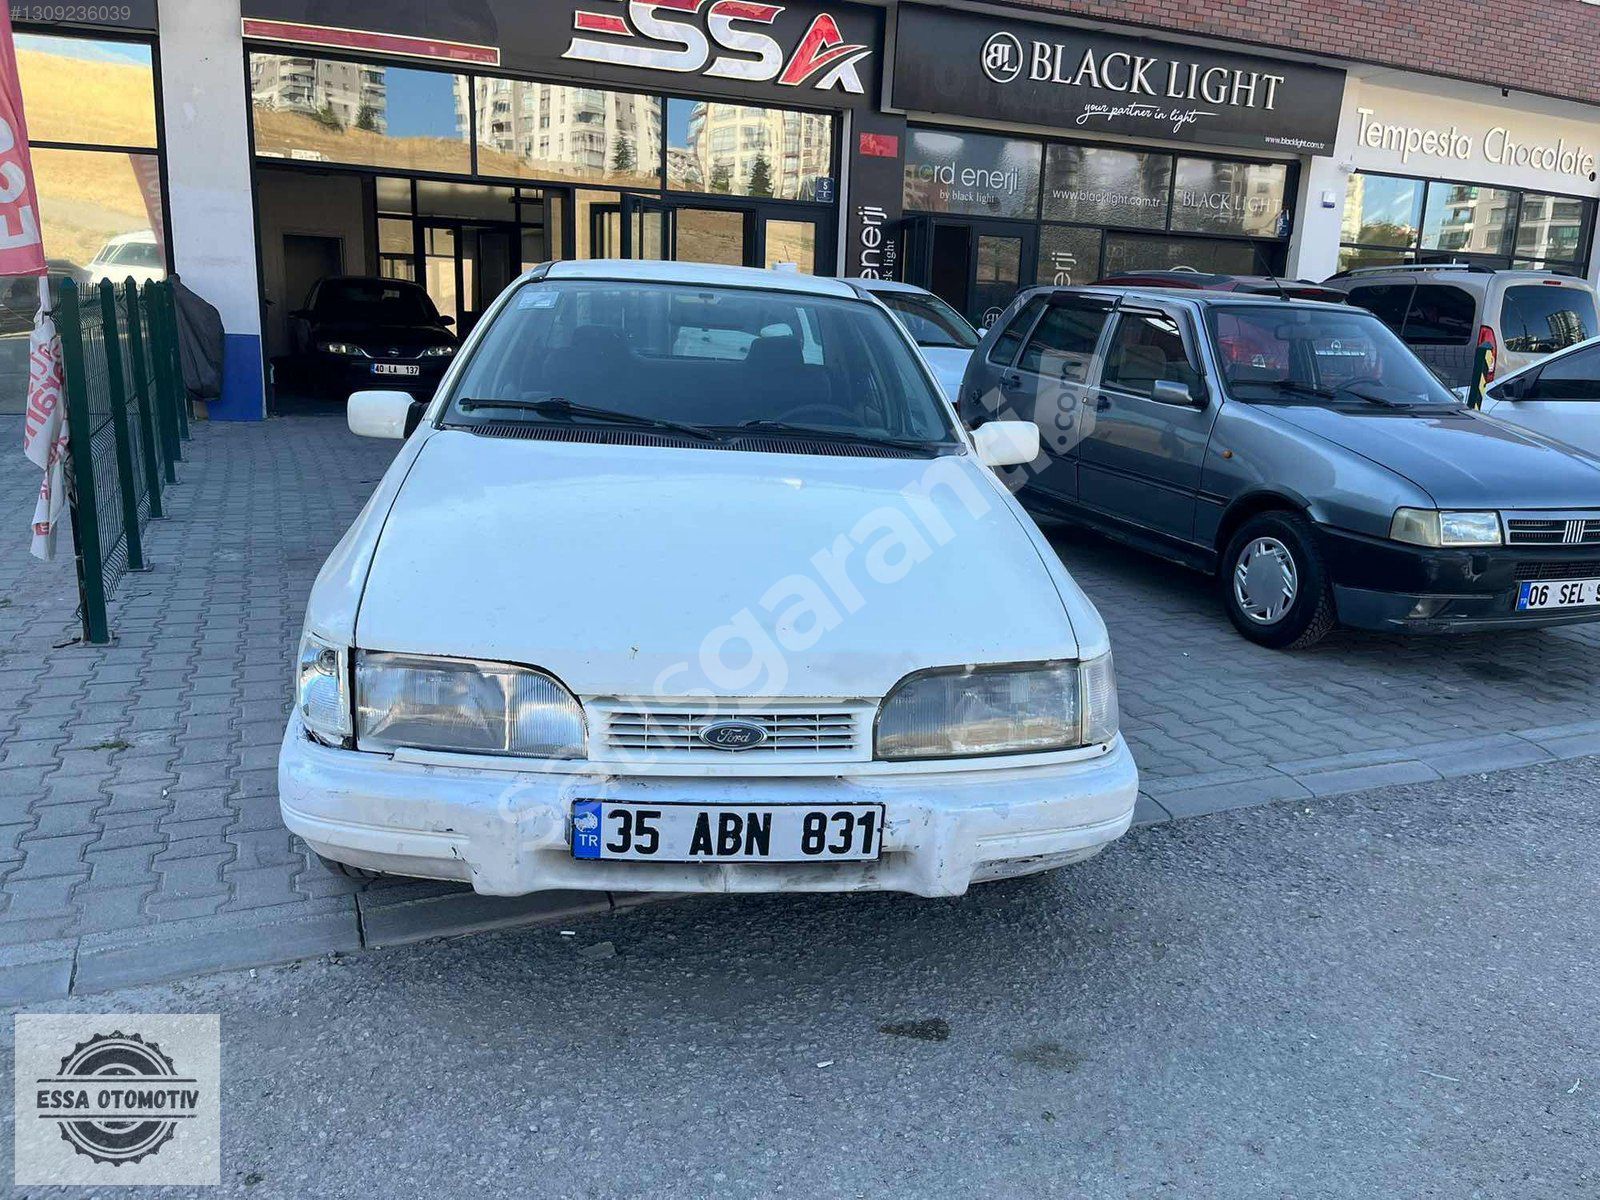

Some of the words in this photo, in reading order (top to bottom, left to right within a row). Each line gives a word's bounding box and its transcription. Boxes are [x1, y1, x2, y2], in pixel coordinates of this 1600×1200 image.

[1029, 41, 1158, 96] BLACK
[1166, 61, 1286, 111] LIGHT
[1076, 103, 1110, 125] your
[1107, 102, 1153, 121] partner
[1154, 108, 1168, 120] in
[1169, 108, 1211, 133] light
[1264, 136, 1325, 149] www.blacklight.com.tr
[1357, 108, 1472, 164] Tempesta
[1483, 127, 1595, 176] Chocolate
[961, 167, 1019, 195] enerji
[939, 189, 949, 202] by
[952, 190, 974, 202] black
[976, 193, 995, 205] light
[1052, 189, 1161, 208] www.blacklight.com.tr
[1182, 191, 1231, 210] BLACK
[1234, 195, 1282, 213] LIGHT
[883, 240, 897, 267] light
[406, 366, 419, 374] 137
[1528, 585, 1550, 606] 06
[1558, 583, 1585, 604] SEL
[716, 727, 752, 744] Ford
[578, 833, 598, 848] TR
[605, 809, 662, 855] 35
[688, 812, 773, 857] ABN
[800, 811, 876, 855] 831
